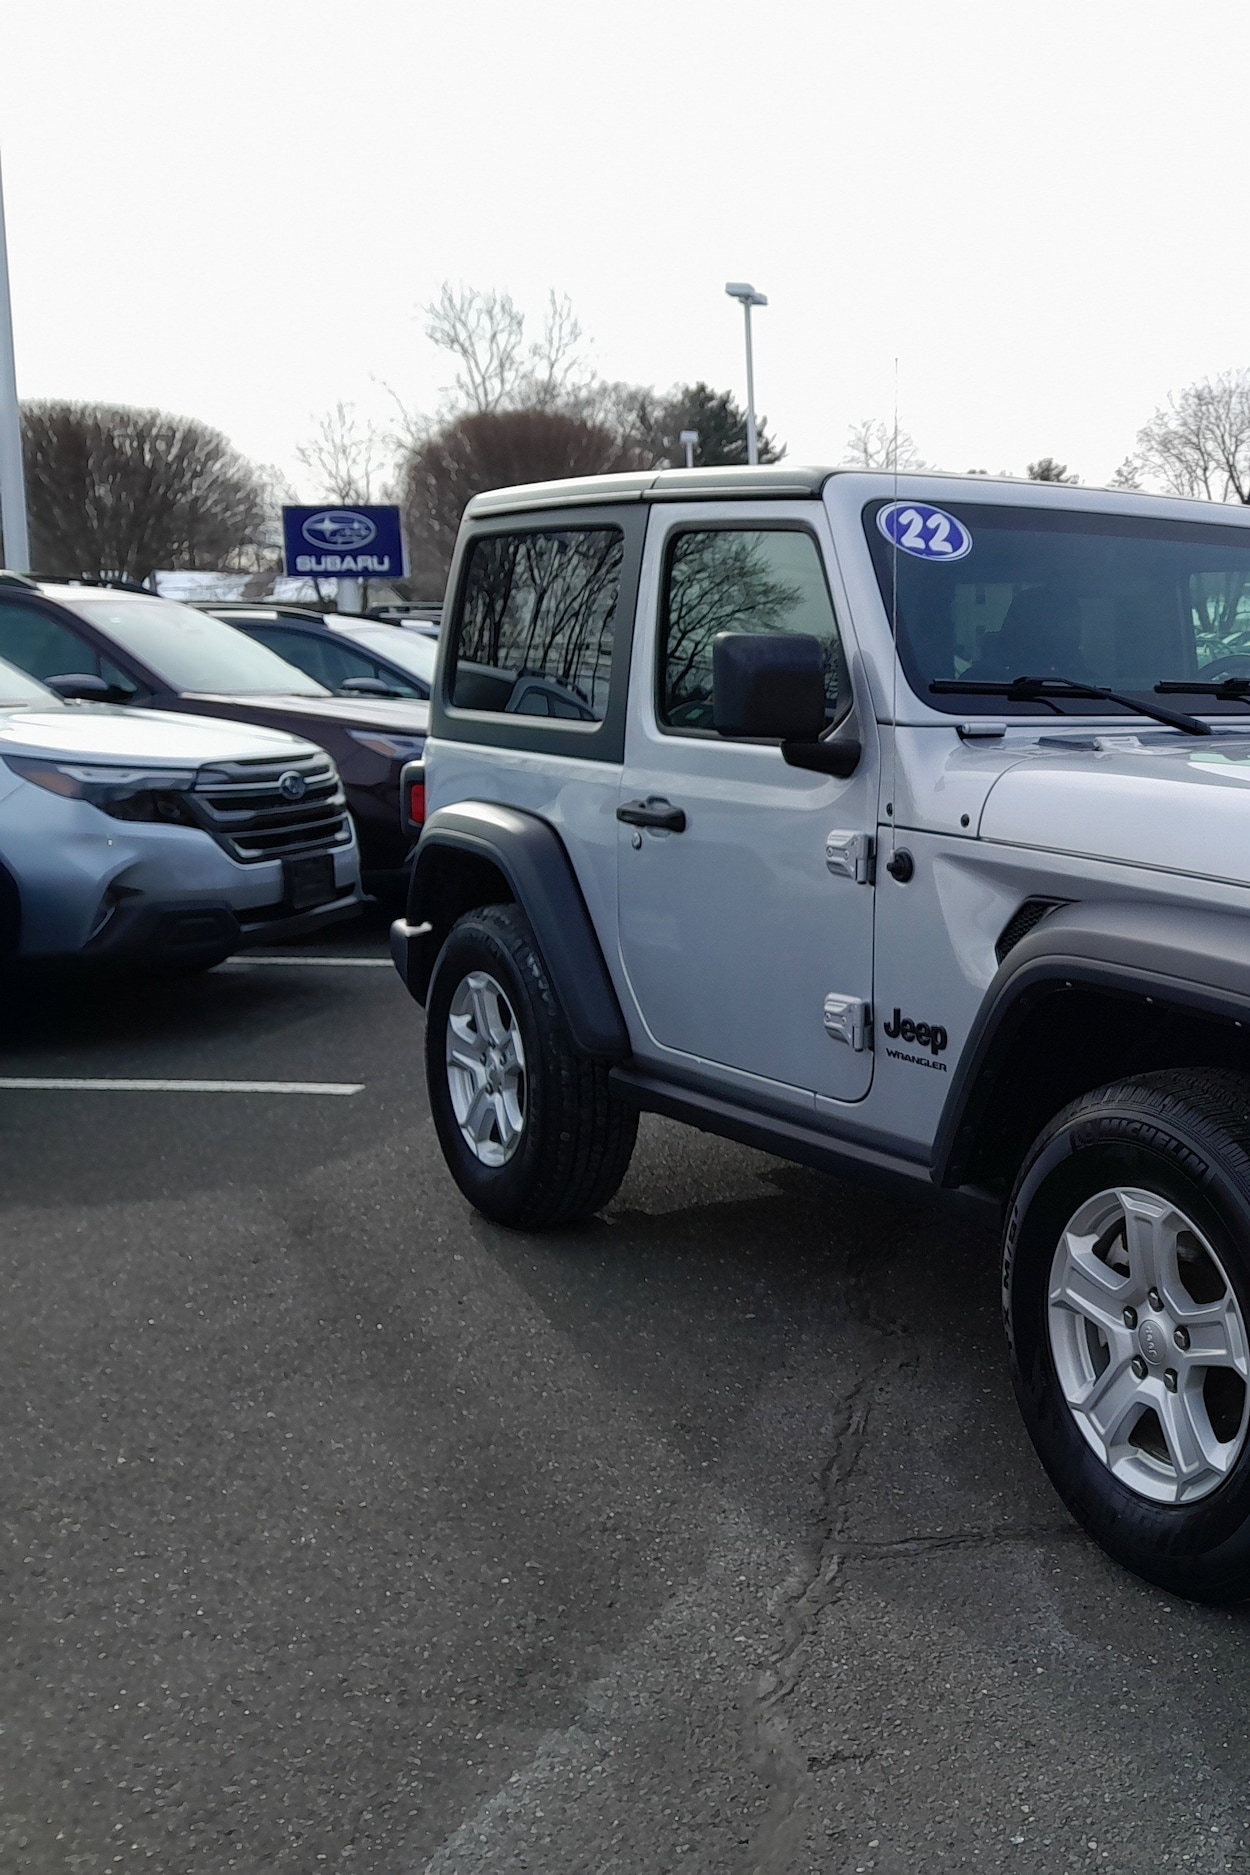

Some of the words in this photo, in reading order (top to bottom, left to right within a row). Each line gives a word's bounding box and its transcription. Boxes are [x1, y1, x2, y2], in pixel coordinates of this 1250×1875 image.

[898, 508, 953, 553] 22
[296, 554, 391, 573] SUBARU
[884, 1007, 948, 1056] Jeep
[885, 1047, 947, 1073] WRANGLER
[1098, 1118, 1210, 1178] MICHELIN
